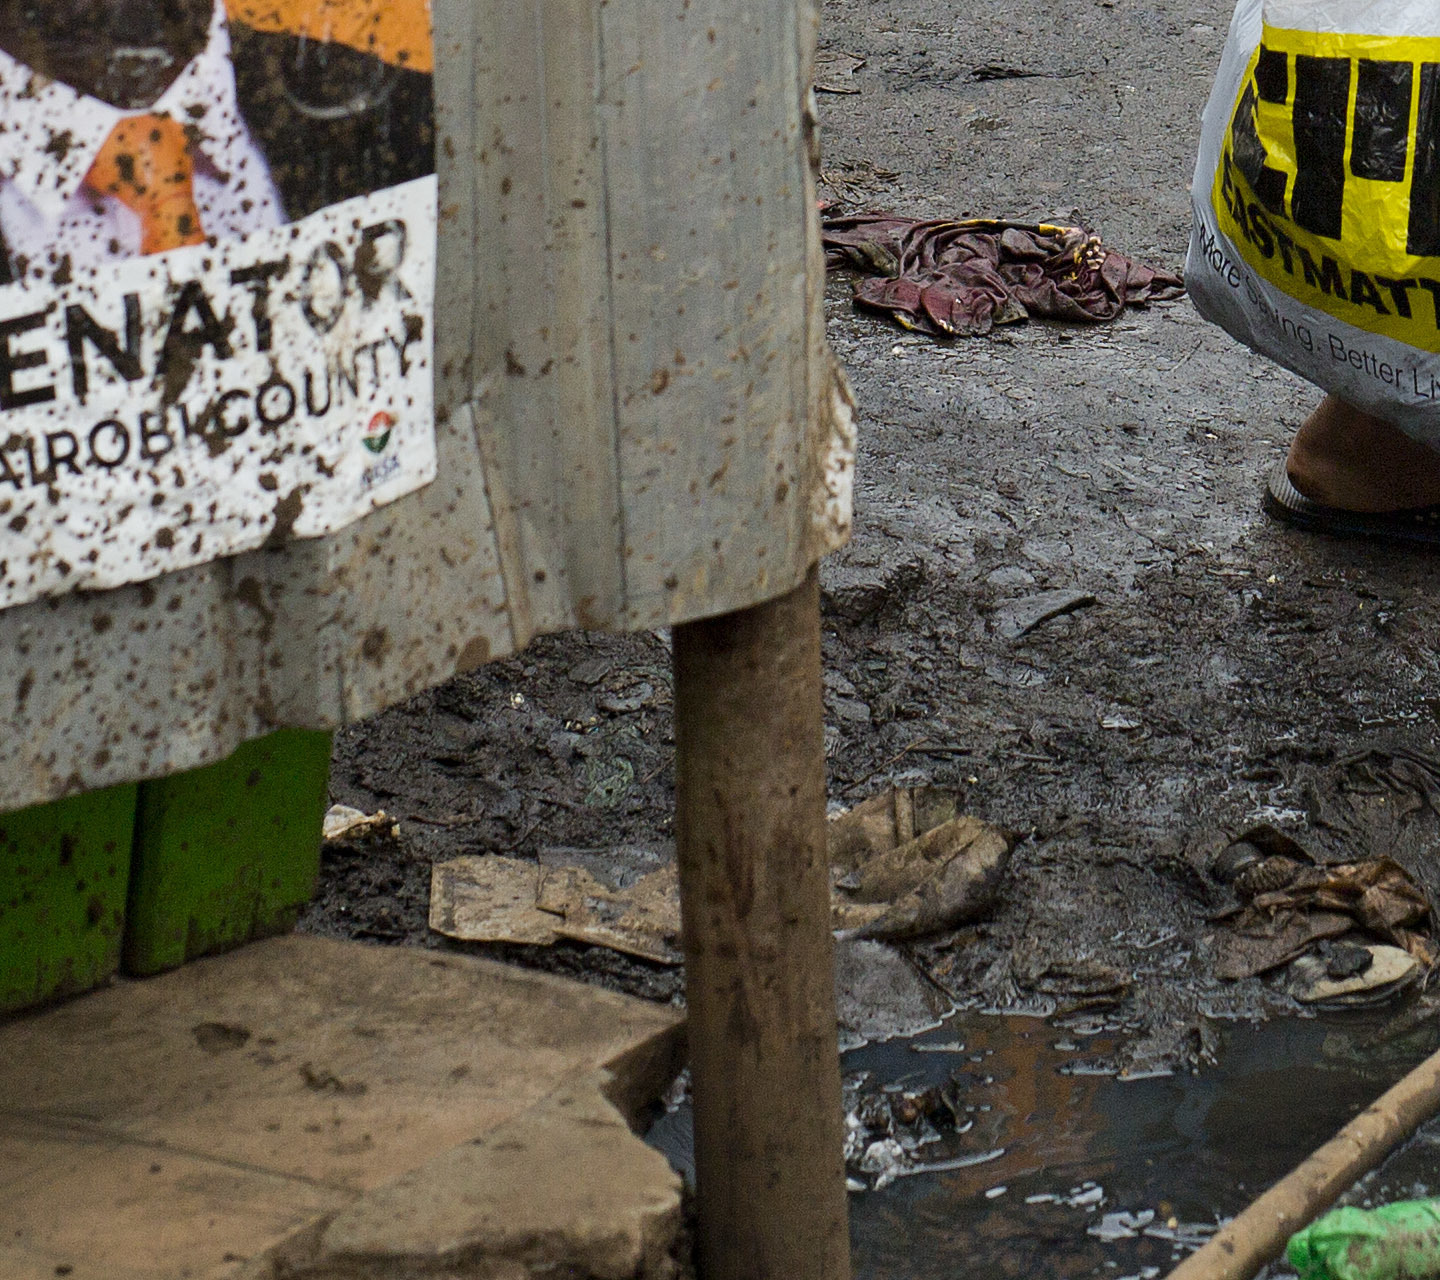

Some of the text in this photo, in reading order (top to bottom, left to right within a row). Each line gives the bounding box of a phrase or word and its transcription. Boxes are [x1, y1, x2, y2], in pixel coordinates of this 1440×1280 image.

[1199, 224, 1242, 290] More
[1328, 332, 1407, 389] Better
[210, 333, 419, 440] COUNTY
